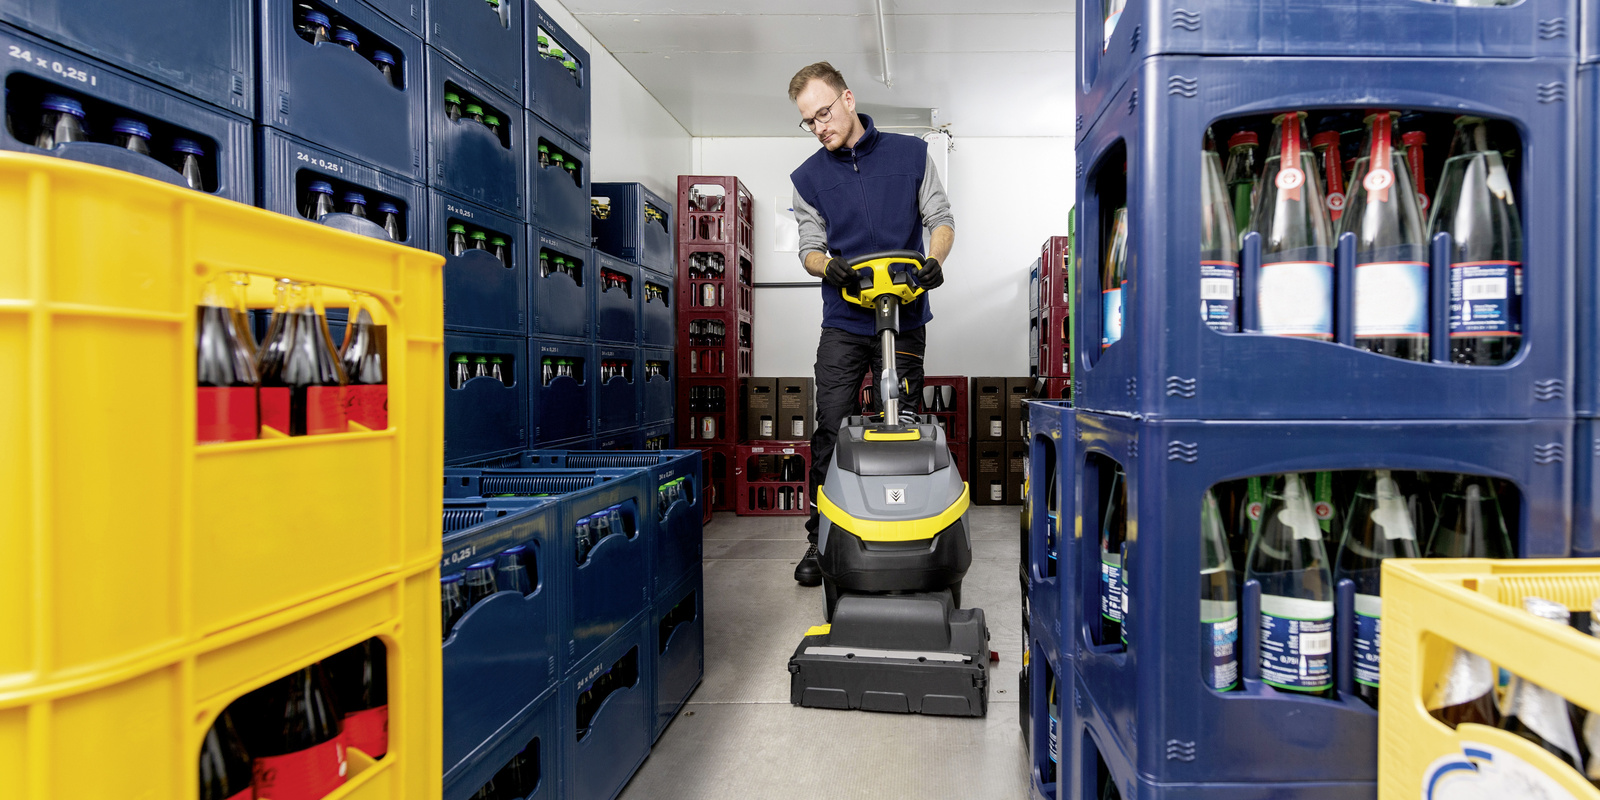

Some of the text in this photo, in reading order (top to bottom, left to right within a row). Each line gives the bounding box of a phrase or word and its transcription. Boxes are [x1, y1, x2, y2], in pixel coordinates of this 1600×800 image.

[8, 45, 33, 62] 24
[36, 57, 48, 69] x
[51, 61, 88, 83] 0,25
[296, 151, 309, 162] 24
[310, 157, 317, 165] x
[319, 159, 339, 172] 0,25
[447, 204, 455, 212] 24
[459, 208, 471, 218] 0,25
[443, 557, 450, 567] x
[451, 547, 471, 564] 0,25
[577, 678, 584, 690] 24
[588, 665, 600, 679] 0,25
